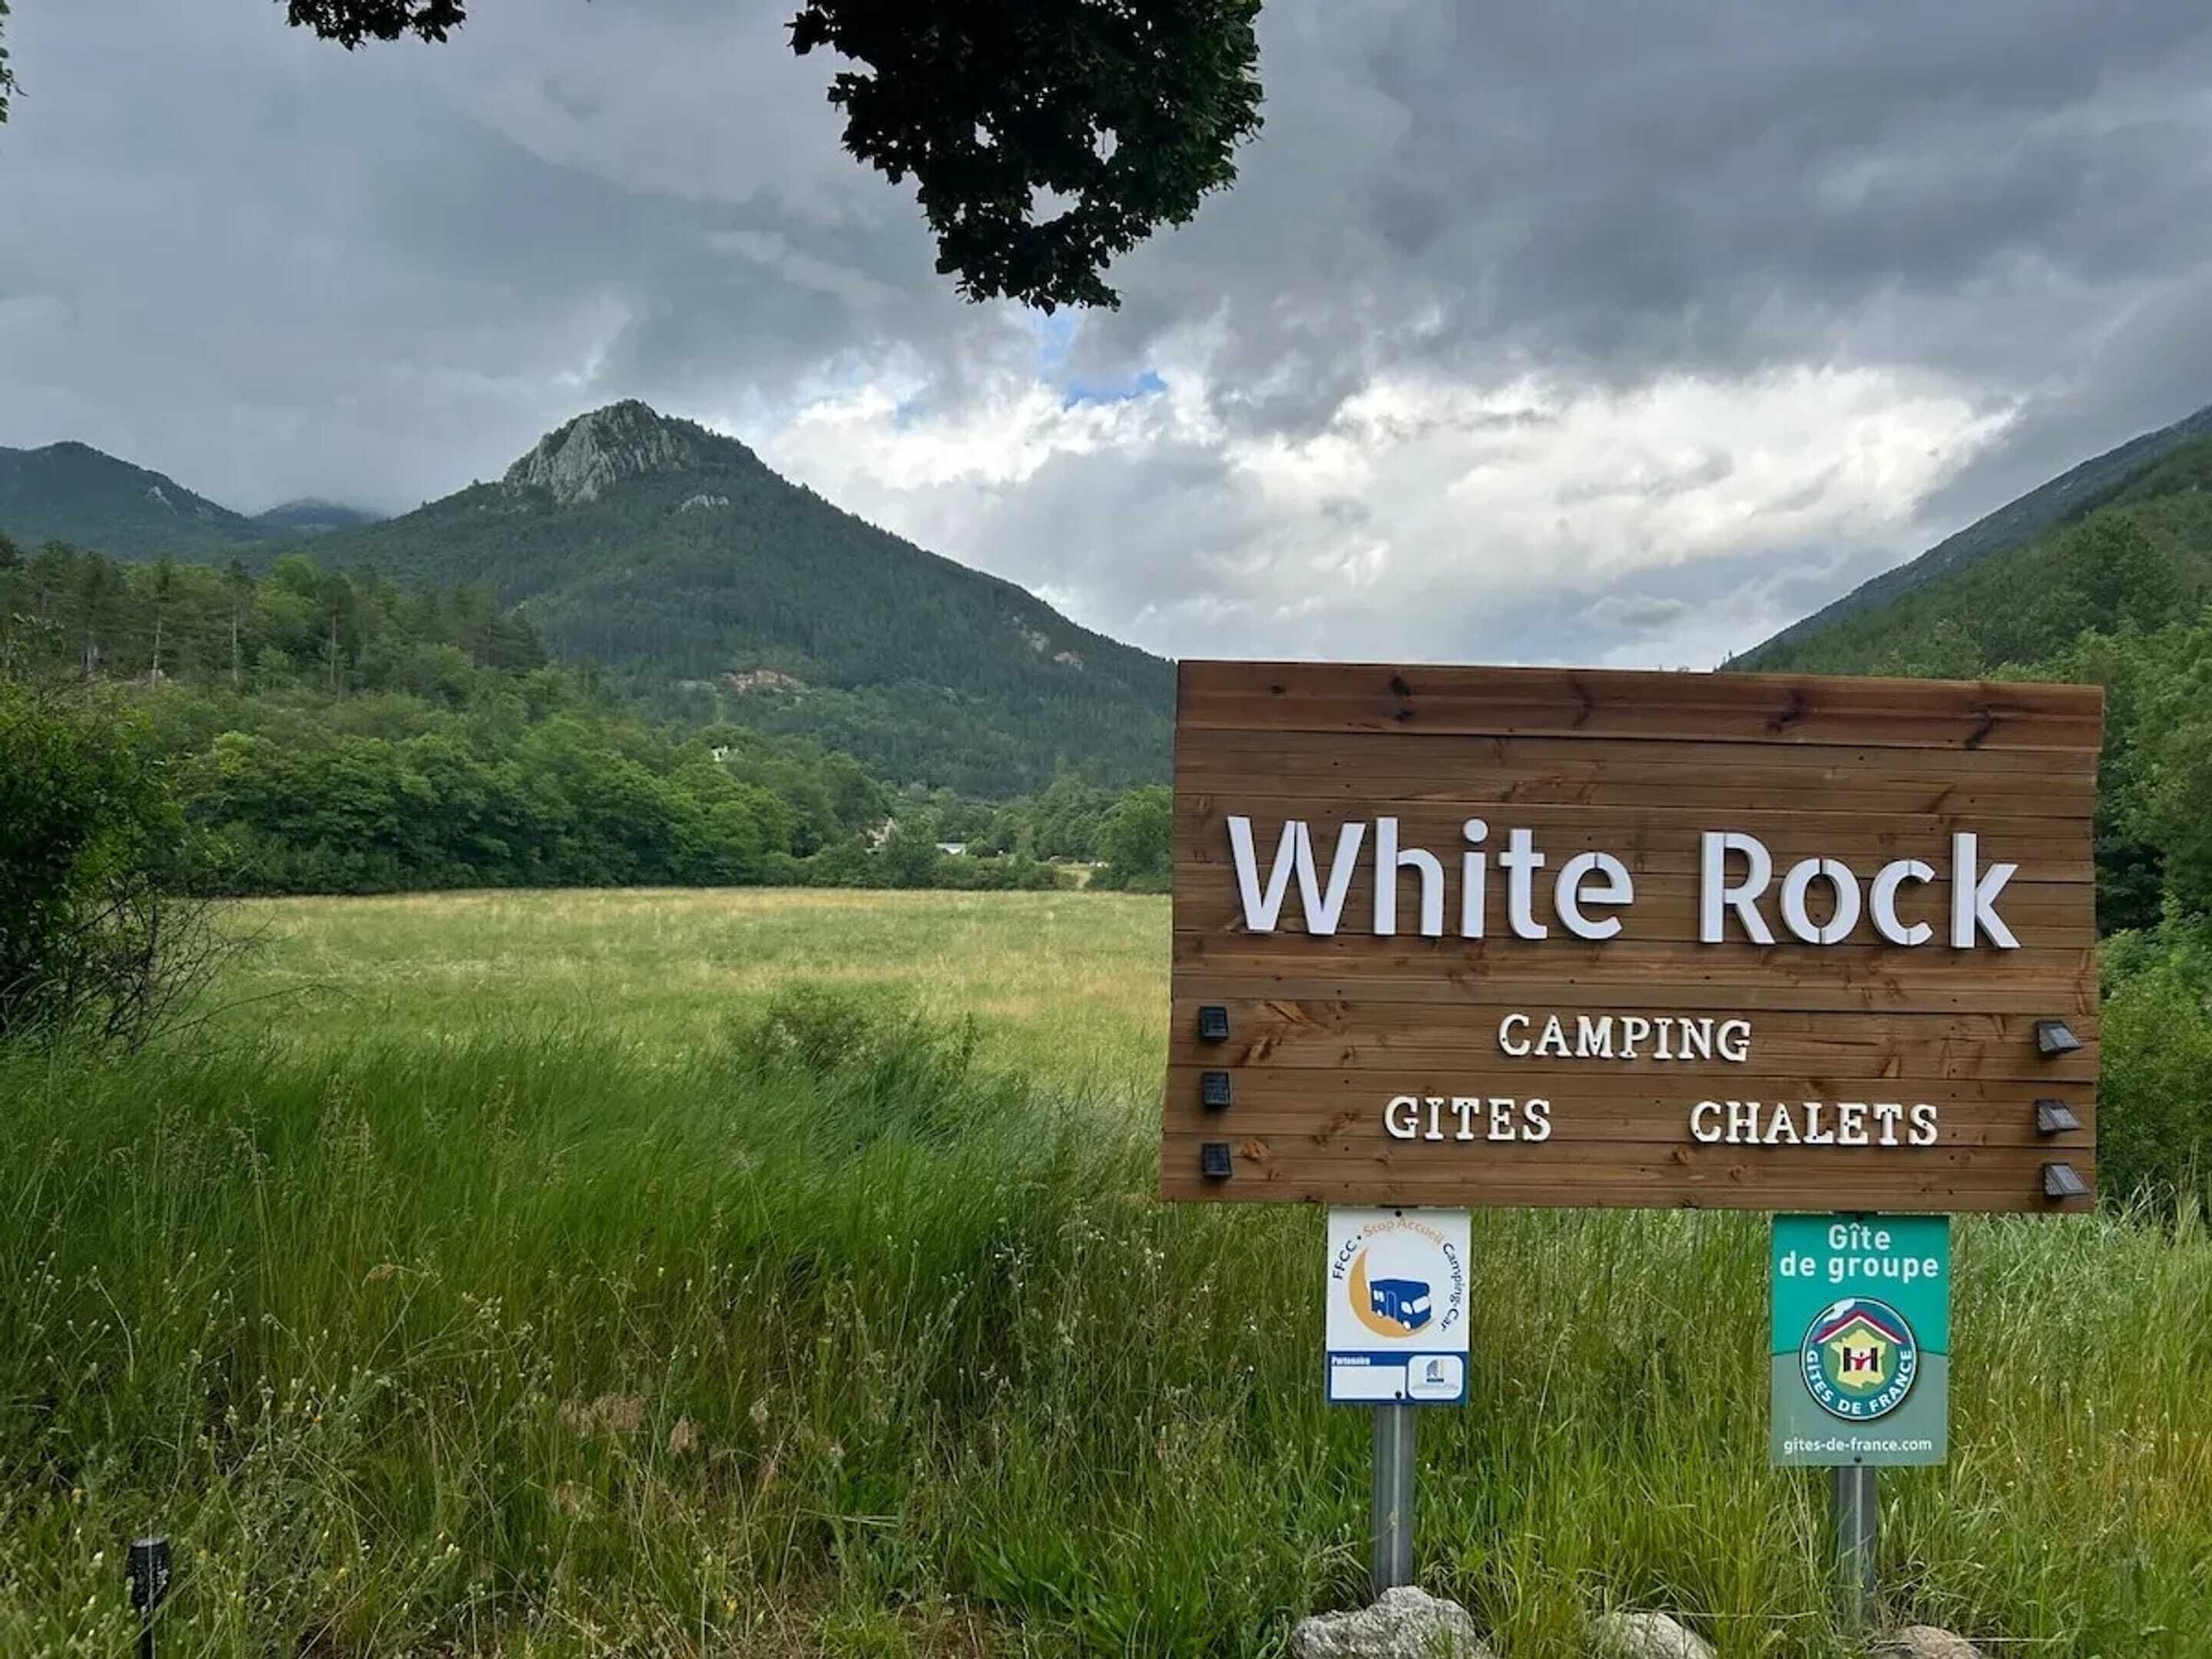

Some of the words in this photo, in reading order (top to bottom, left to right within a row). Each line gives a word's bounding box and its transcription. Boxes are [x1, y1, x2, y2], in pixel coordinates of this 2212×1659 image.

[1227, 816, 1634, 940] White
[1700, 831, 2022, 949] Rock
[1498, 1013, 1751, 1061] CAMPING
[1384, 1096, 1551, 1142] GITES
[1690, 1101, 1939, 1146] CHALETS
[1333, 1240, 1357, 1280] FFCC
[1363, 1220, 1394, 1237] Stop
[1398, 1216, 1444, 1243] Accueil
[1829, 1224, 1892, 1250] Gîte
[1780, 1250, 1816, 1277] de
[1828, 1257, 1939, 1284] groupe
[1838, 1399, 1862, 1415] DE
[1869, 1349, 1912, 1413] FRANCE
[1783, 1437, 1932, 1455] gites-de-france.com
